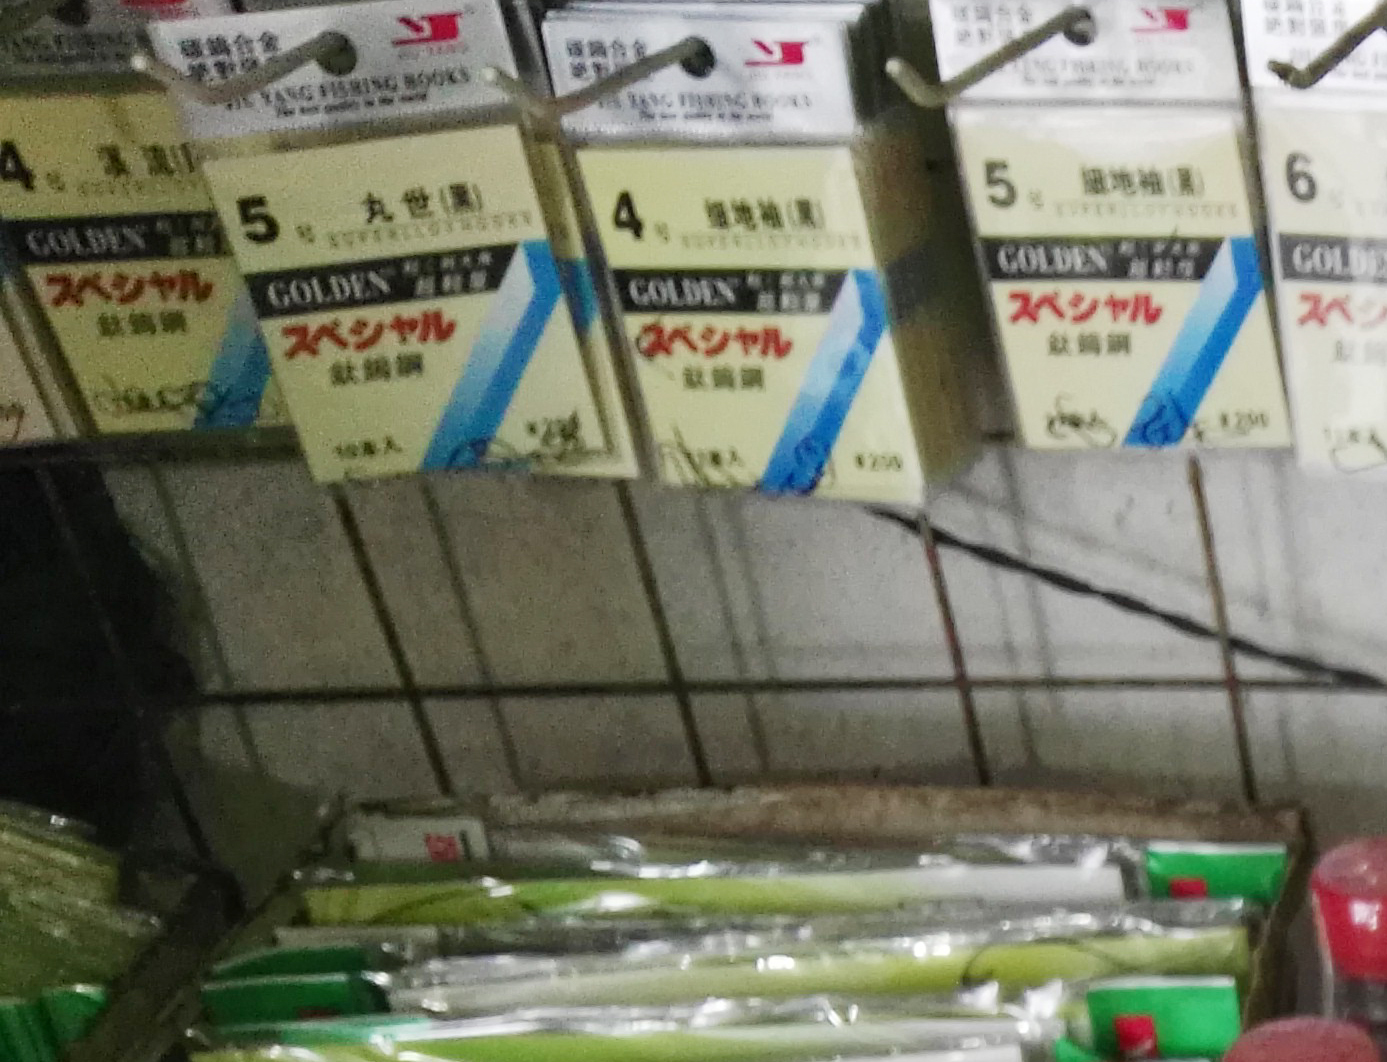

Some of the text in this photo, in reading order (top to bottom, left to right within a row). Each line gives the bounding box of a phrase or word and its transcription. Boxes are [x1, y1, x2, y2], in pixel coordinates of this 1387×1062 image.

[0, 139, 34, 191] 4
[984, 160, 1018, 208] 5
[1285, 153, 1317, 203] 6
[236, 195, 280, 243] 5
[614, 190, 643, 240] 4
[25, 226, 146, 256] GOLDEN
[996, 243, 1108, 274] GOLDEN
[45, 269, 214, 307] スペシャル
[266, 269, 392, 308] GOLDEN
[628, 277, 736, 307] GOLDEN
[1007, 290, 1163, 326] スペシャル
[281, 309, 457, 359] スペシャル
[637, 323, 793, 359] スペシャル
